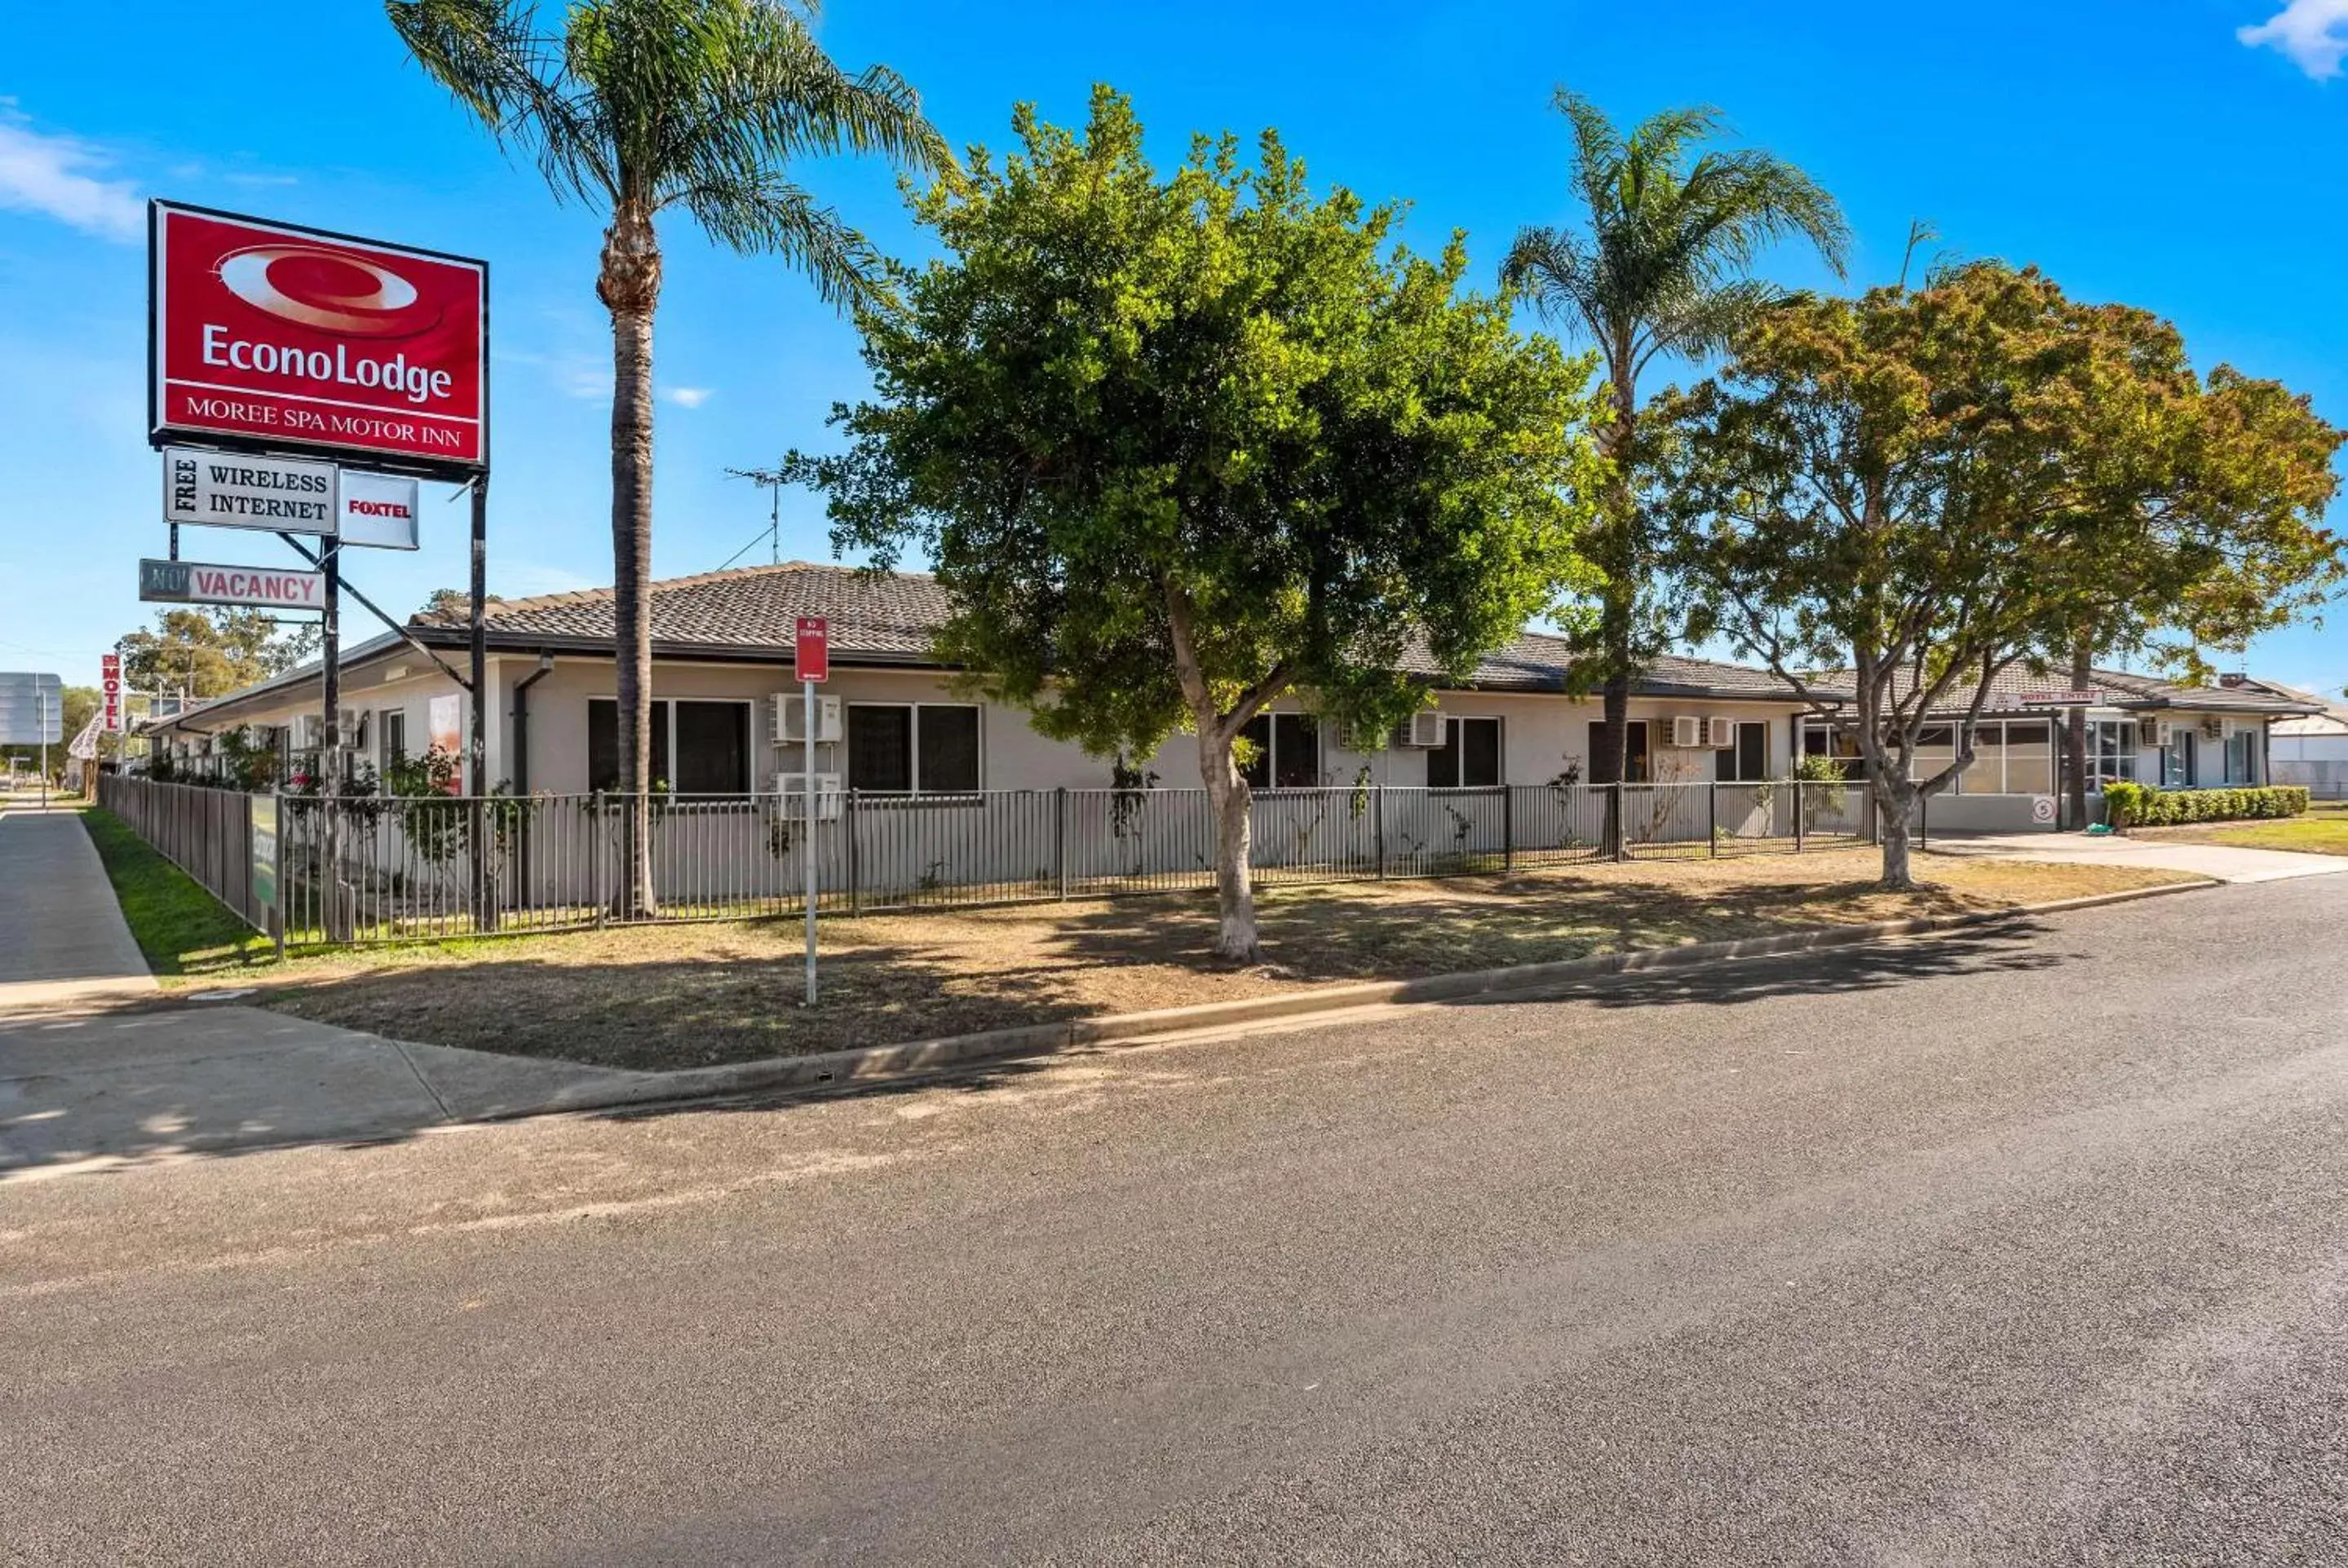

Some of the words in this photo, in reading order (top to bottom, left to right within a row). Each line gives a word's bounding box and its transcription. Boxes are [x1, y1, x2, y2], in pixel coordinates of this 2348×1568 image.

[186, 396, 278, 425] MOREE
[284, 409, 325, 431] SPA
[330, 414, 415, 442] MOTOR
[421, 426, 461, 448] INN
[175, 458, 197, 512] FREE
[209, 465, 327, 493] WIRELESS
[210, 493, 328, 520] INTERNET
[348, 499, 412, 519] FOXTEL
[196, 571, 316, 602] VACANCY
[103, 667, 120, 729] MOTEL
